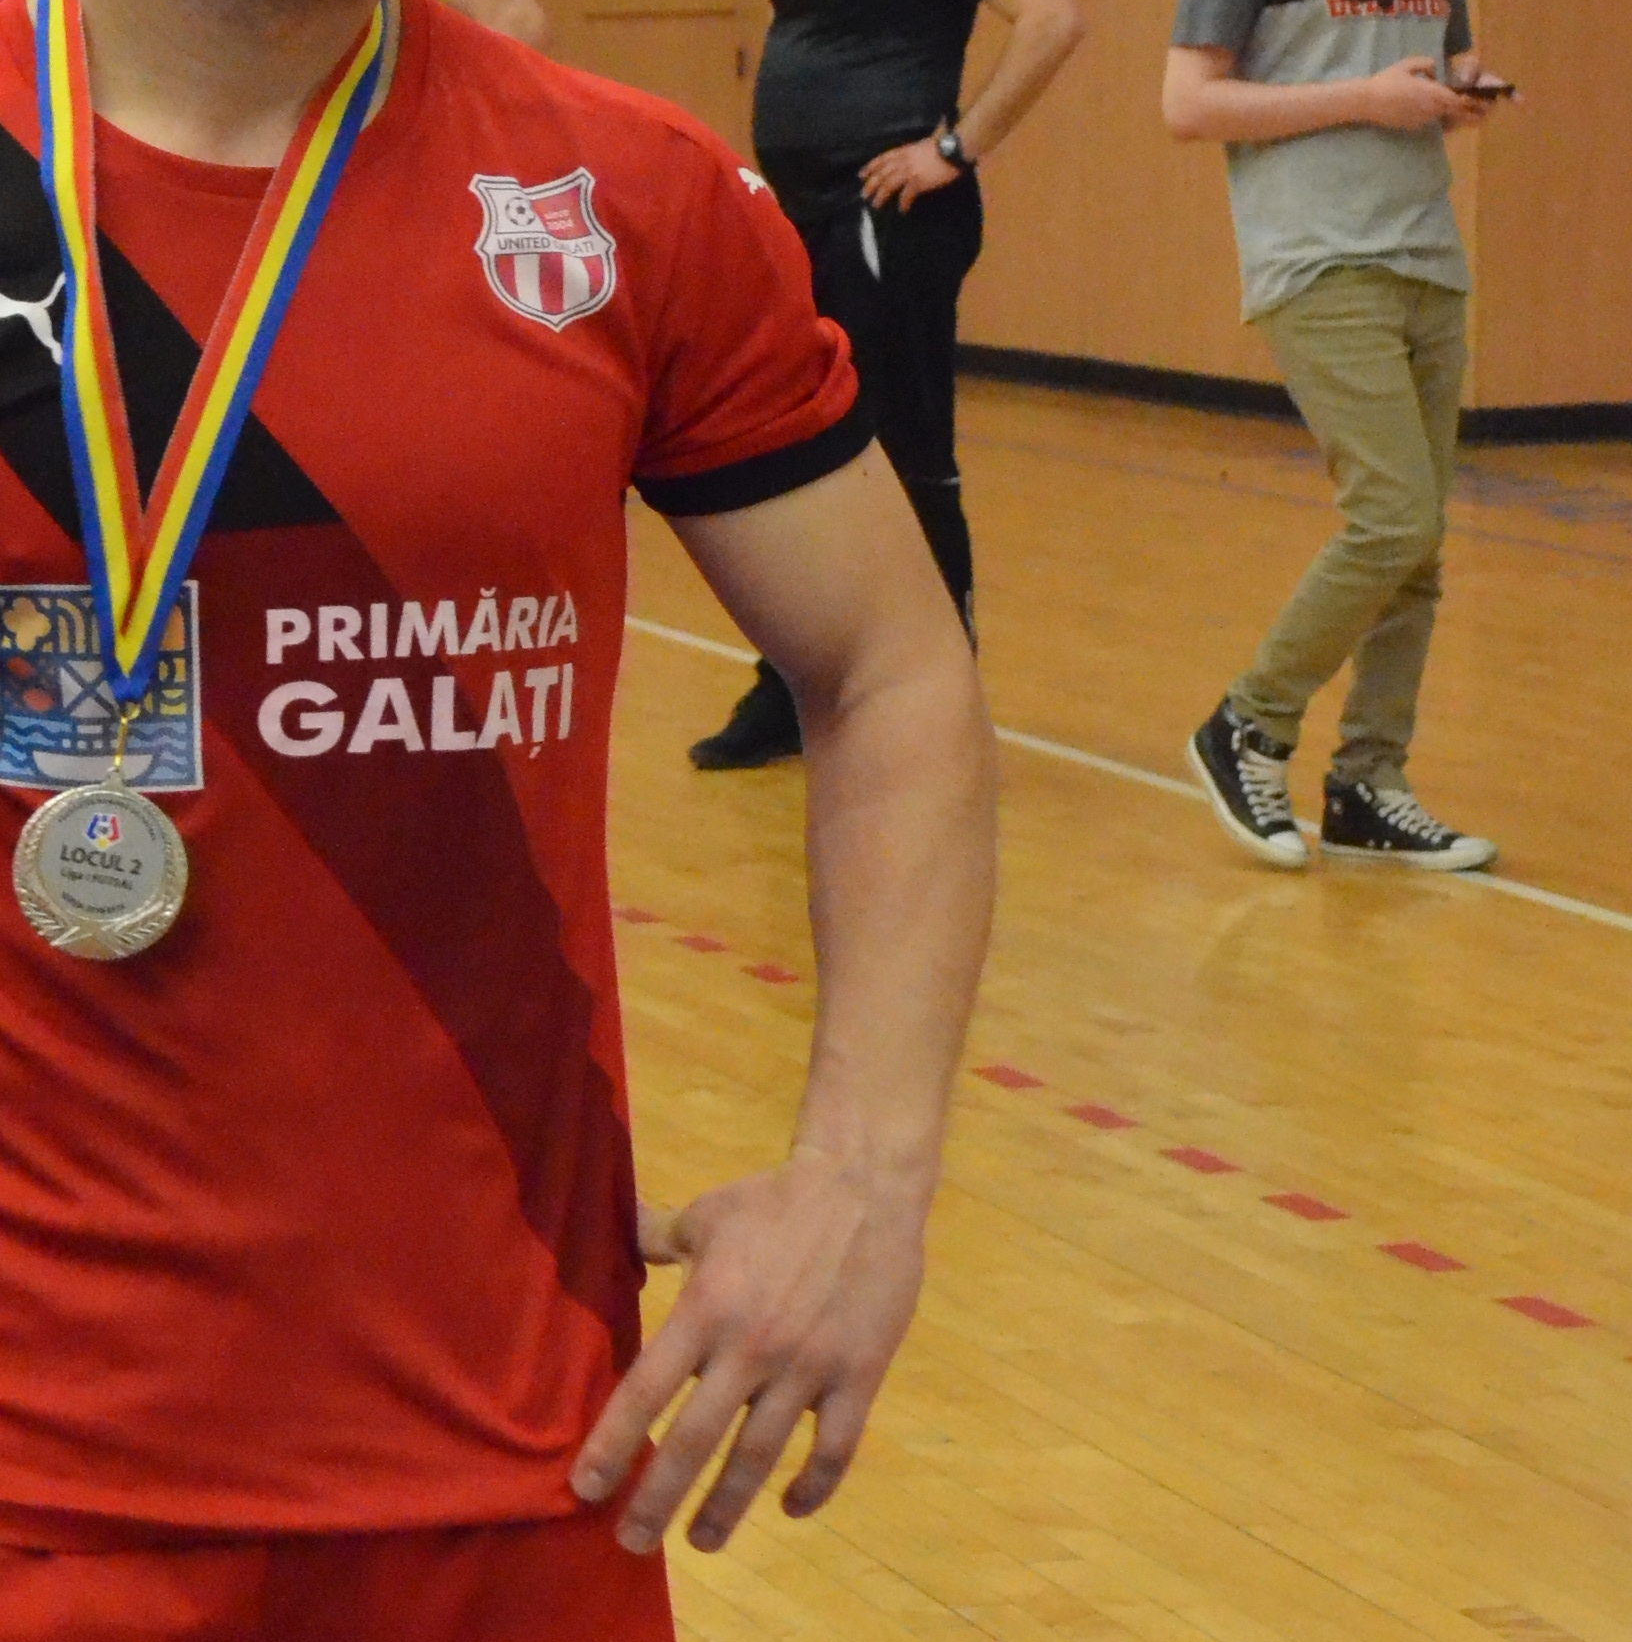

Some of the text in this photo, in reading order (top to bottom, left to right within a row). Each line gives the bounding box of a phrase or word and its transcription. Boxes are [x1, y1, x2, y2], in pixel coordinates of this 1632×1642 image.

[497, 236, 551, 251] UNITED
[266, 587, 578, 665] PRIMĂRIA
[257, 663, 574, 760] GALAȚI
[60, 845, 144, 876] LOCUL 2
